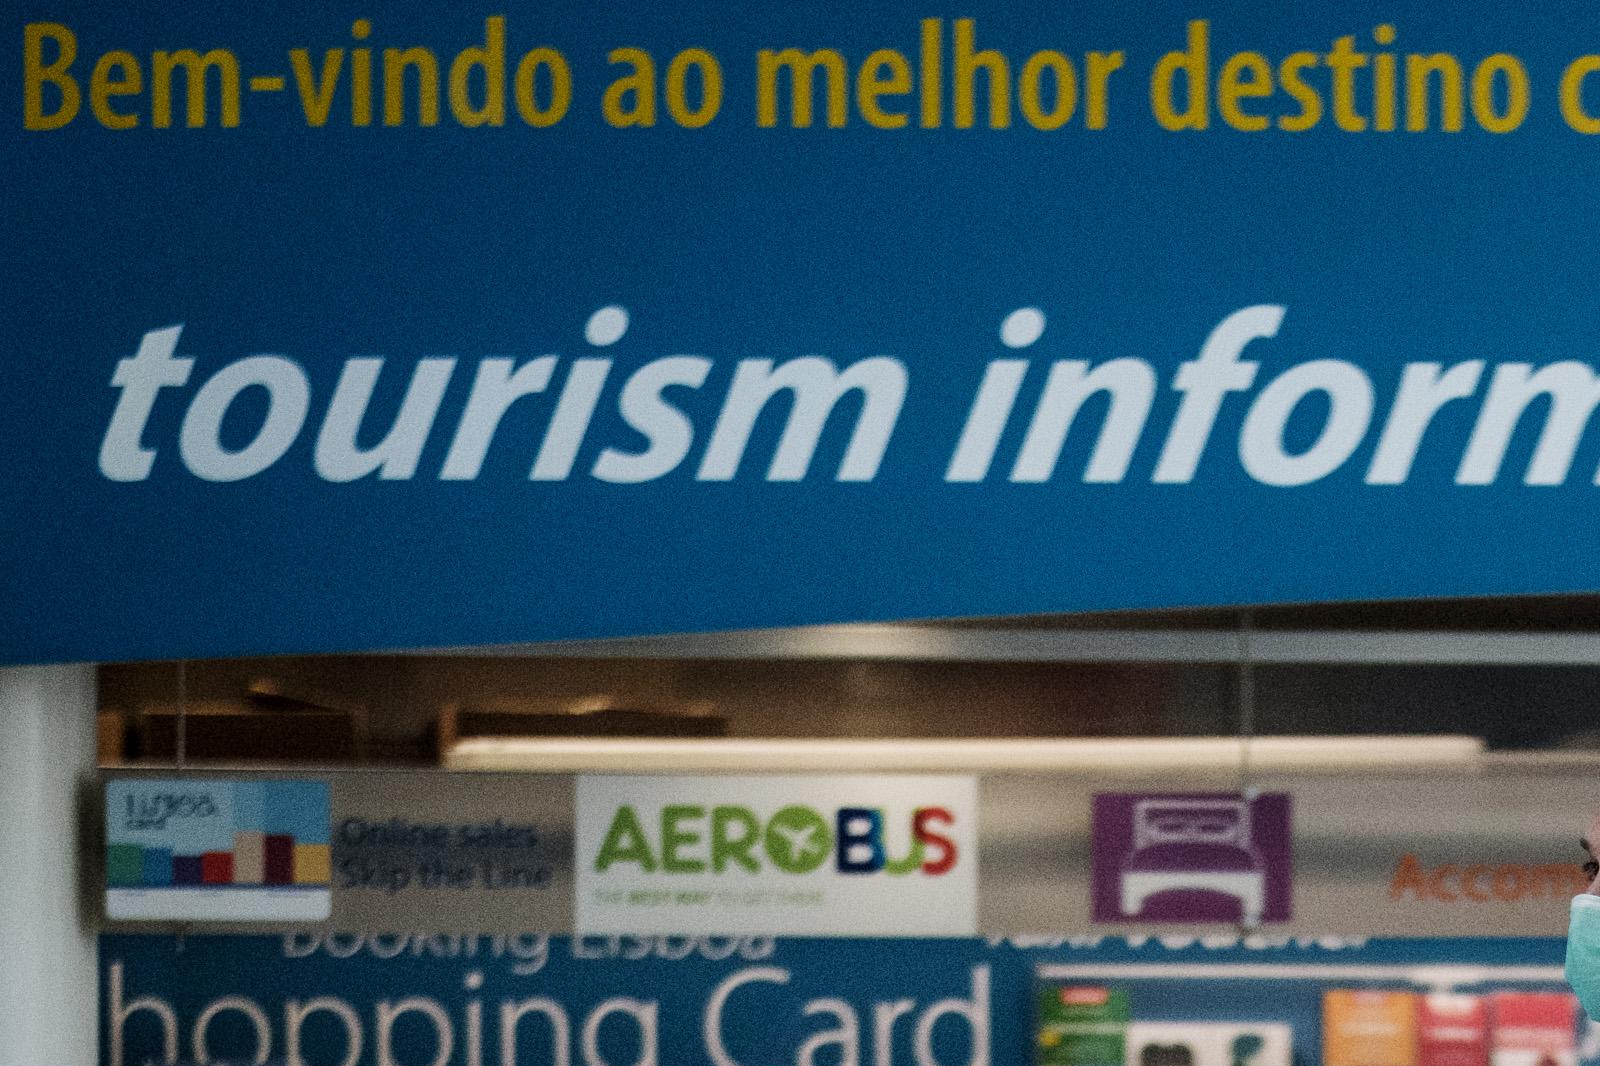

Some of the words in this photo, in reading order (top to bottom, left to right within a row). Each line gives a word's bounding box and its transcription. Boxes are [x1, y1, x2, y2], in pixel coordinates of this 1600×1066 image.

[22, 15, 573, 131] Bem-vindo
[602, 46, 724, 129] ao
[756, 17, 1126, 131] melhor
[1150, 19, 1531, 134] destino
[98, 305, 909, 484] tourism
[594, 804, 960, 877] AEROBUS
